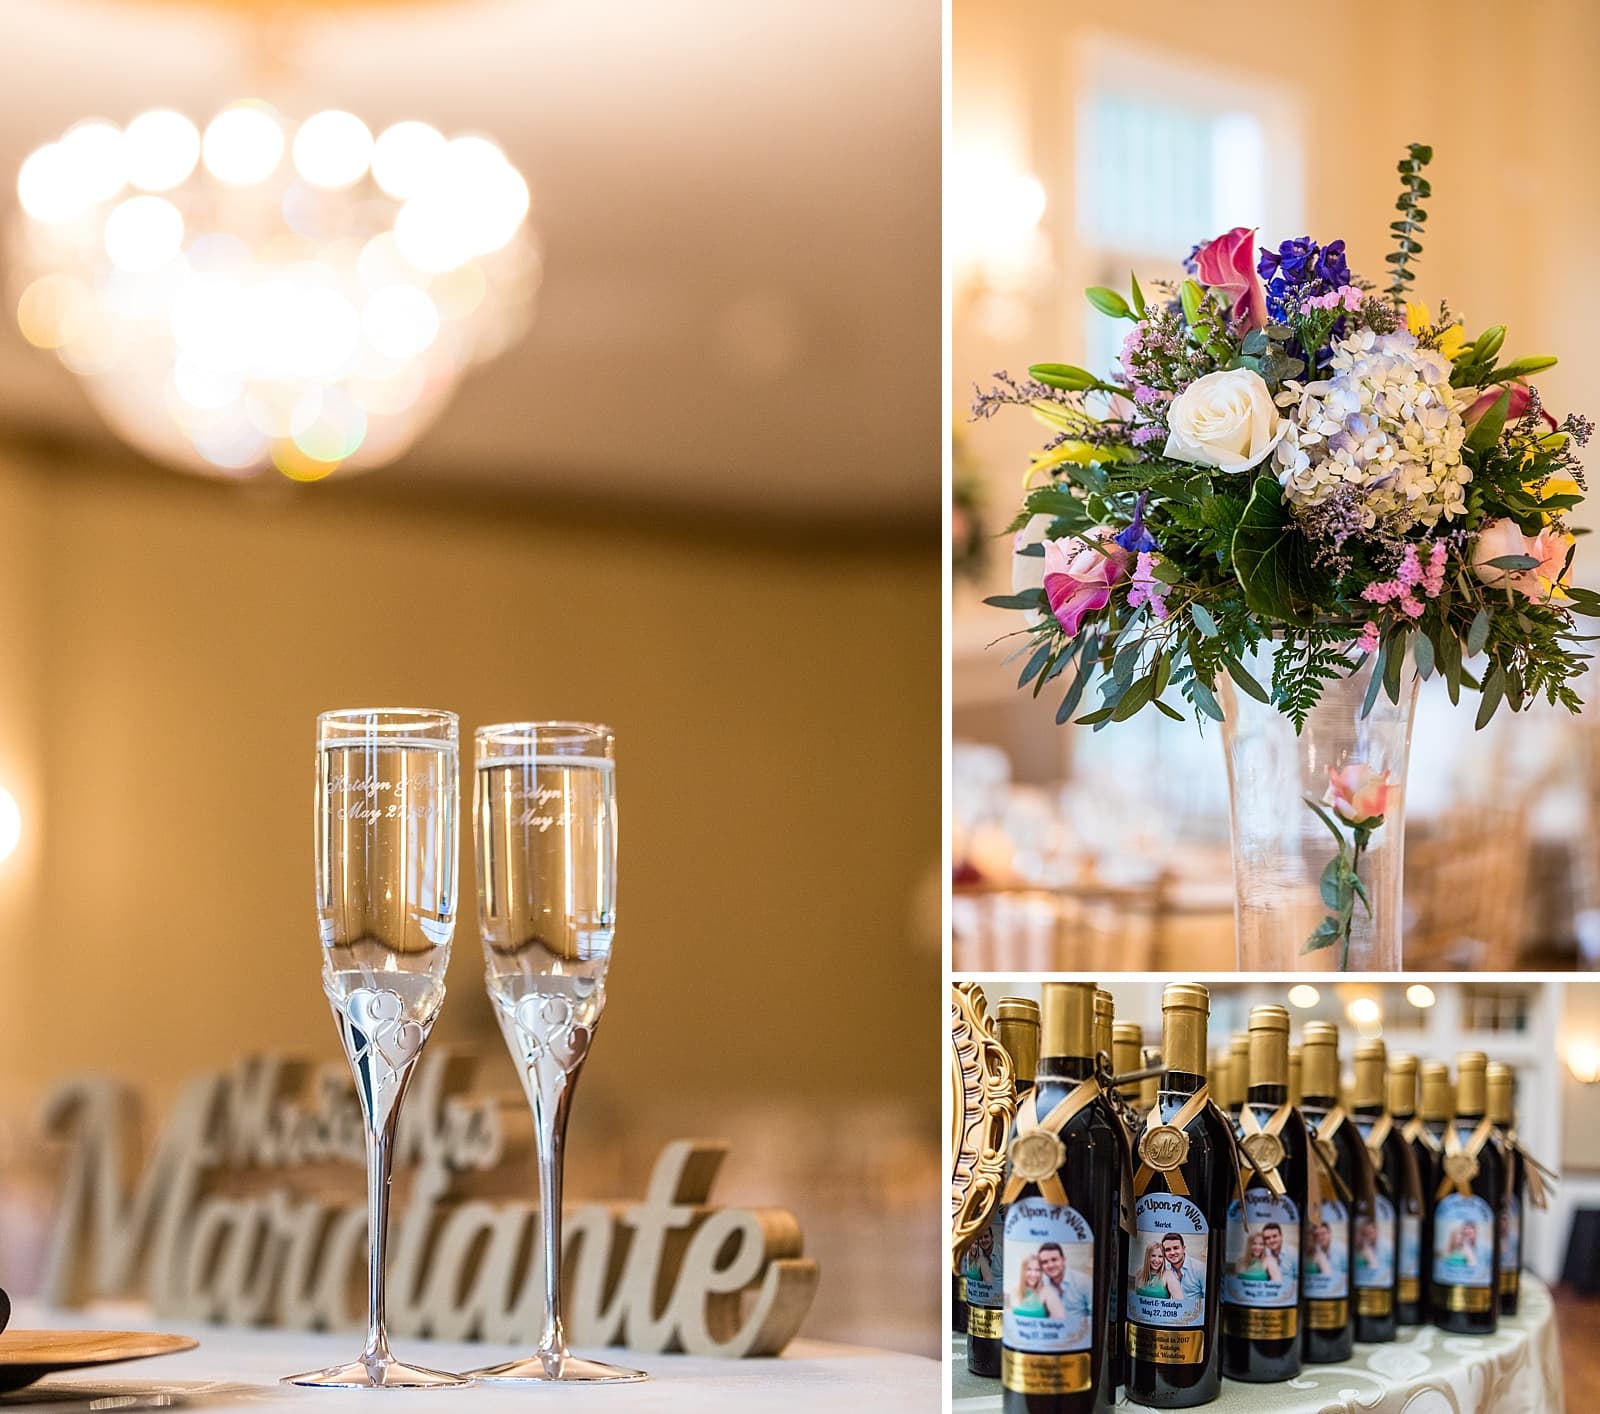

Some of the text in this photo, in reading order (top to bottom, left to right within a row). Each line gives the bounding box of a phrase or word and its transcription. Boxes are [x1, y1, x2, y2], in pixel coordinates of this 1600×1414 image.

[337, 801, 382, 825] May
[1144, 1198, 1171, 1213] Upon
[1172, 1201, 1182, 1213] A
[1184, 1204, 1203, 1232] Wine
[1154, 1220, 1172, 1229] Merlot
[1141, 1307, 1153, 1318] May
[1163, 1310, 1178, 1318] 2018
